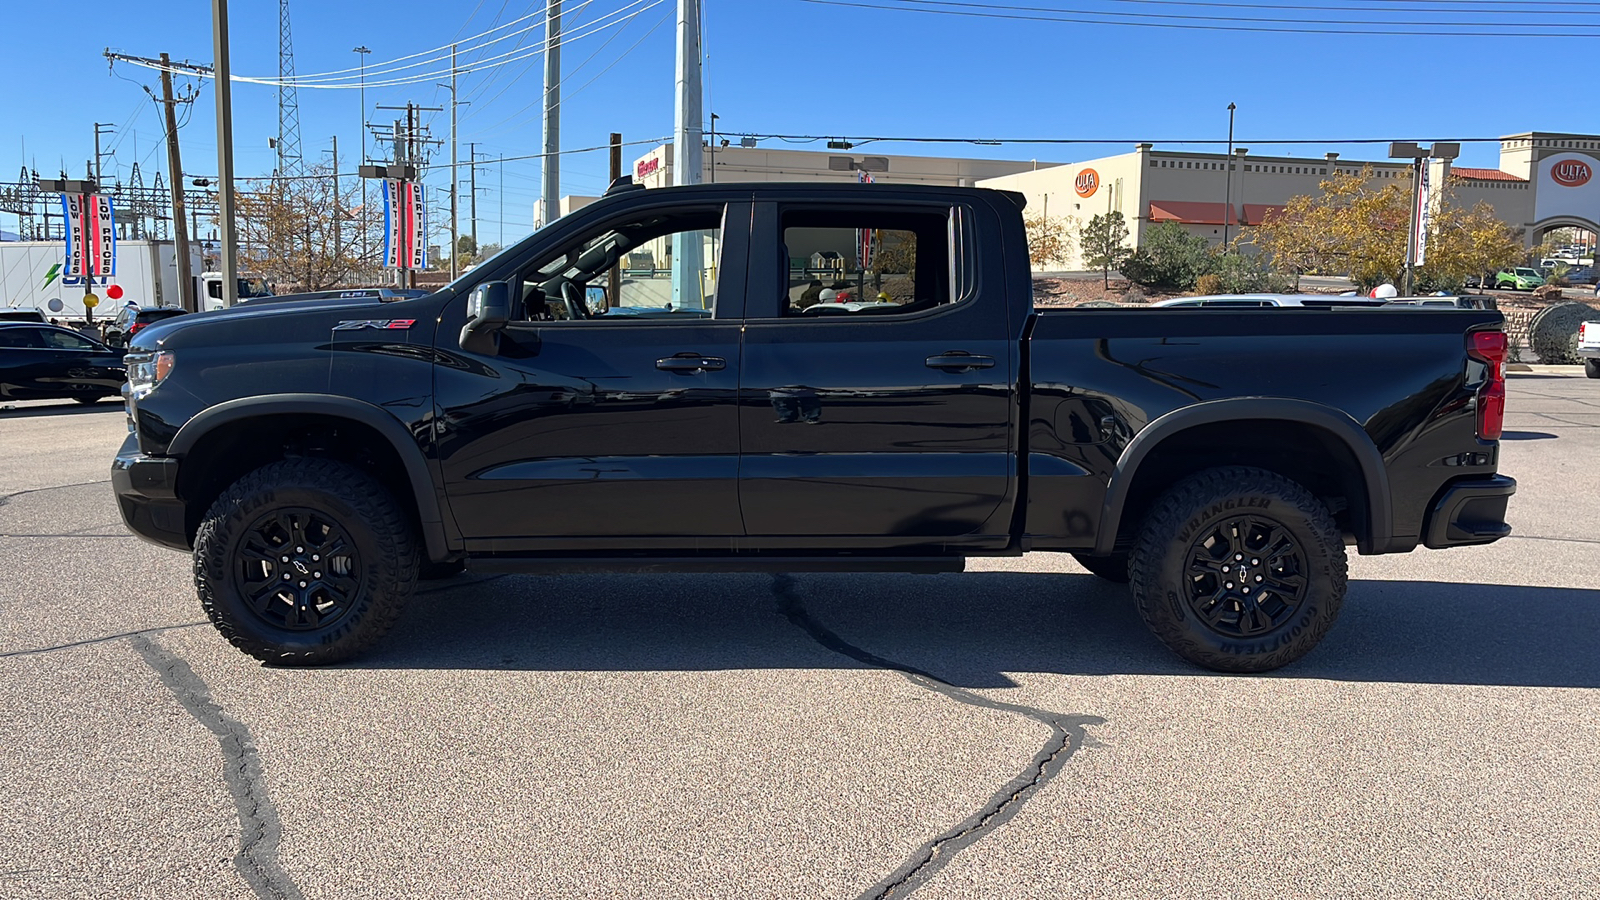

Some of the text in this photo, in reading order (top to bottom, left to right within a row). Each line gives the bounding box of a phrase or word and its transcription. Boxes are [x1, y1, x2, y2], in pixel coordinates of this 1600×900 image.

[1077, 173, 1097, 189] ULTA
[1560, 164, 1588, 177] ULTA
[69, 196, 81, 274] LOW PRICES
[99, 197, 111, 274] LOW PRICES
[389, 182, 399, 265] CERTIFIED
[413, 185, 423, 265] CERTIFIED
[1178, 497, 1272, 543] WRANGLER
